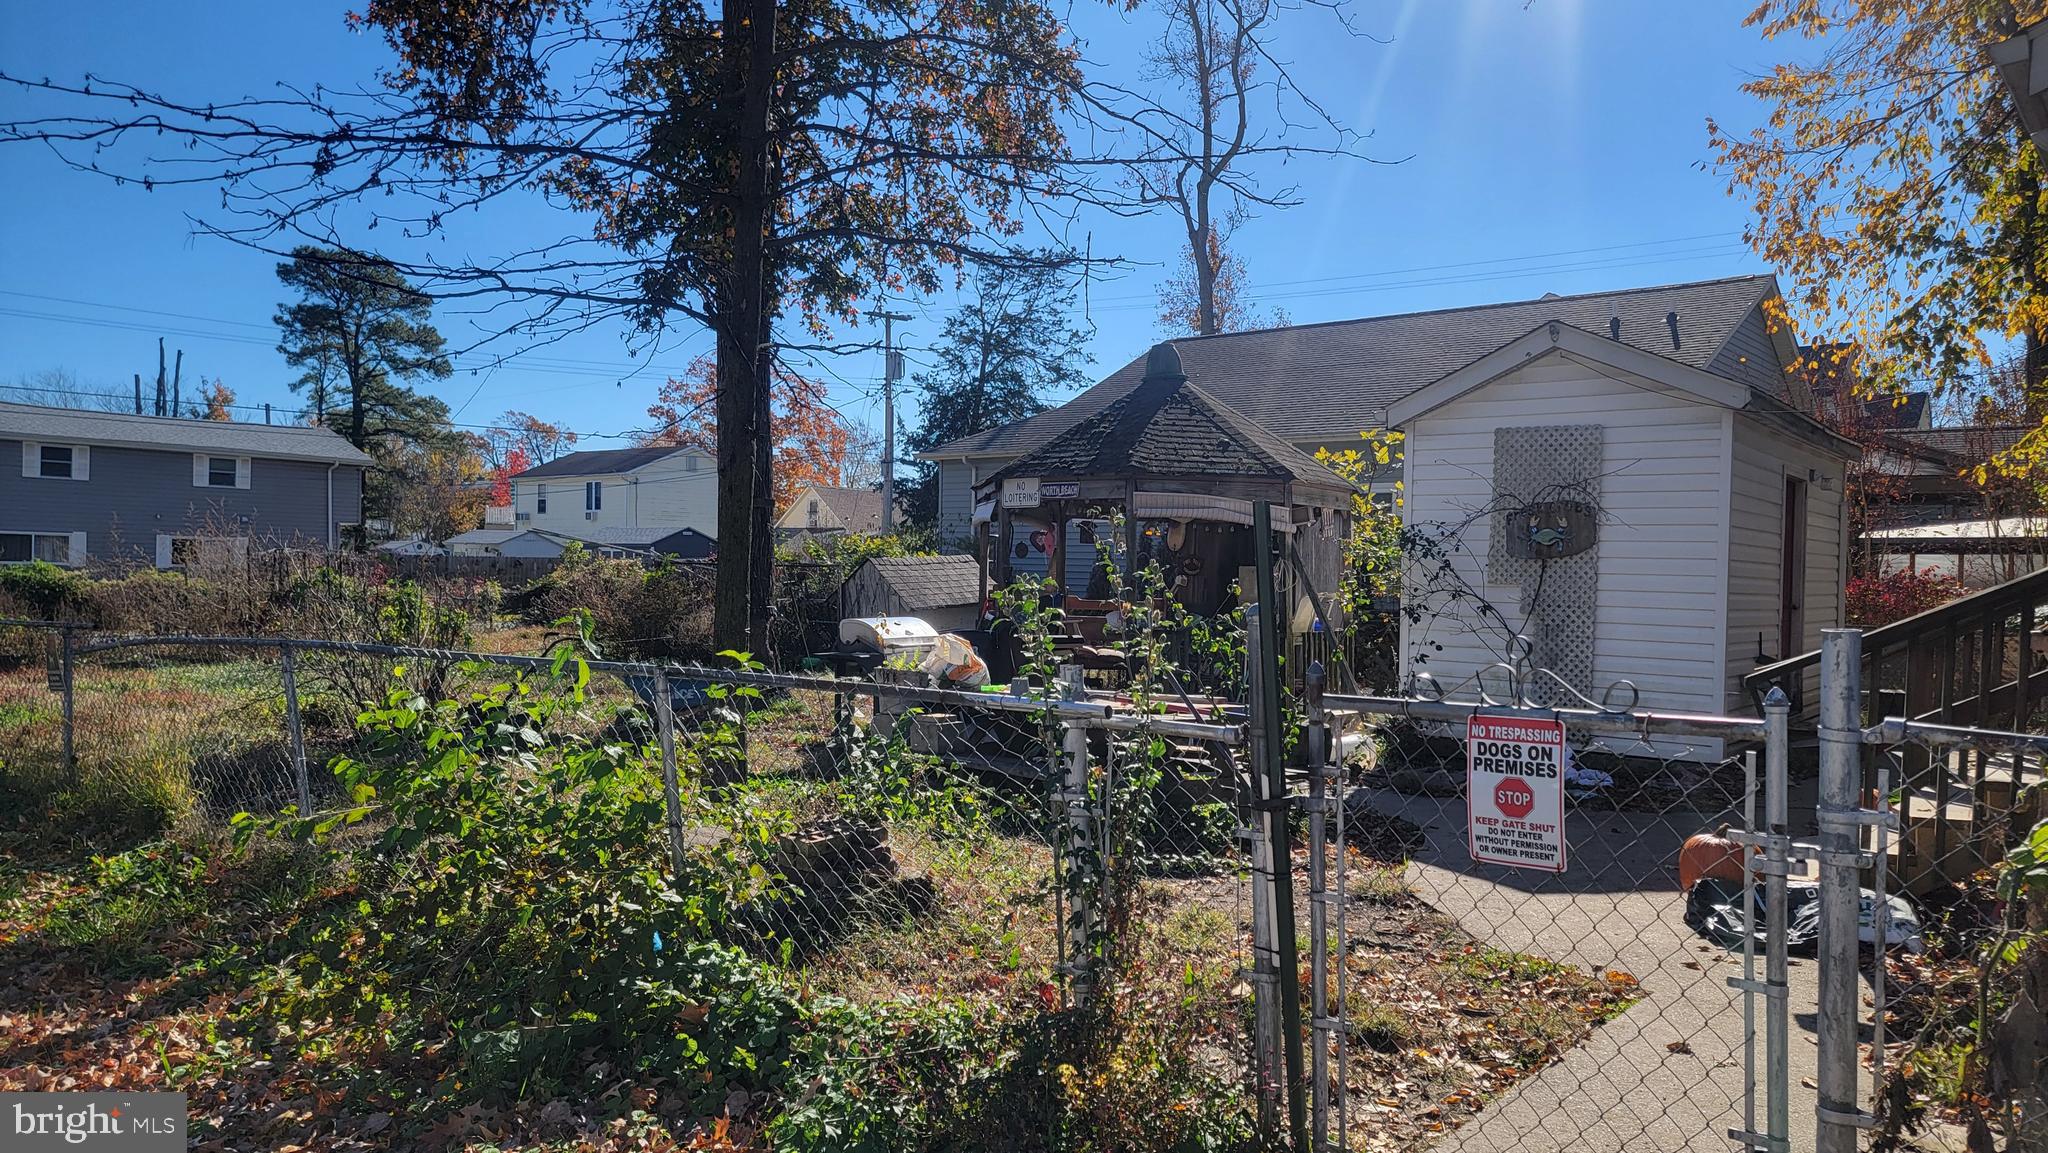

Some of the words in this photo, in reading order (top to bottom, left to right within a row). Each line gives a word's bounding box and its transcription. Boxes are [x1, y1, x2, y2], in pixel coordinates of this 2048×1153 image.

[1016, 481, 1026, 491] NO
[1060, 485, 1079, 496] BEACH
[1004, 492, 1038, 503] LOITERING
[1471, 725, 1486, 737] NO
[1488, 726, 1560, 743] TRESPASSING
[1477, 741, 1522, 759] DOGS
[1527, 745, 1553, 762] ON
[1473, 757, 1557, 778] PREMISES
[1498, 790, 1531, 806] STOP
[1475, 816, 1499, 826] KEEP
[1501, 819, 1526, 830] GATE
[1529, 823, 1556, 833] SHUT
[1488, 827, 1499, 835] DO
[1500, 829, 1516, 838] NOT
[1517, 831, 1543, 841] ENTER
[1475, 834, 1509, 846] WITHOUT
[1510, 839, 1558, 852] PERMISSION
[1479, 845, 1490, 853] OR
[1490, 846, 1518, 857] OWNER
[1519, 850, 1555, 861] PRESENT
